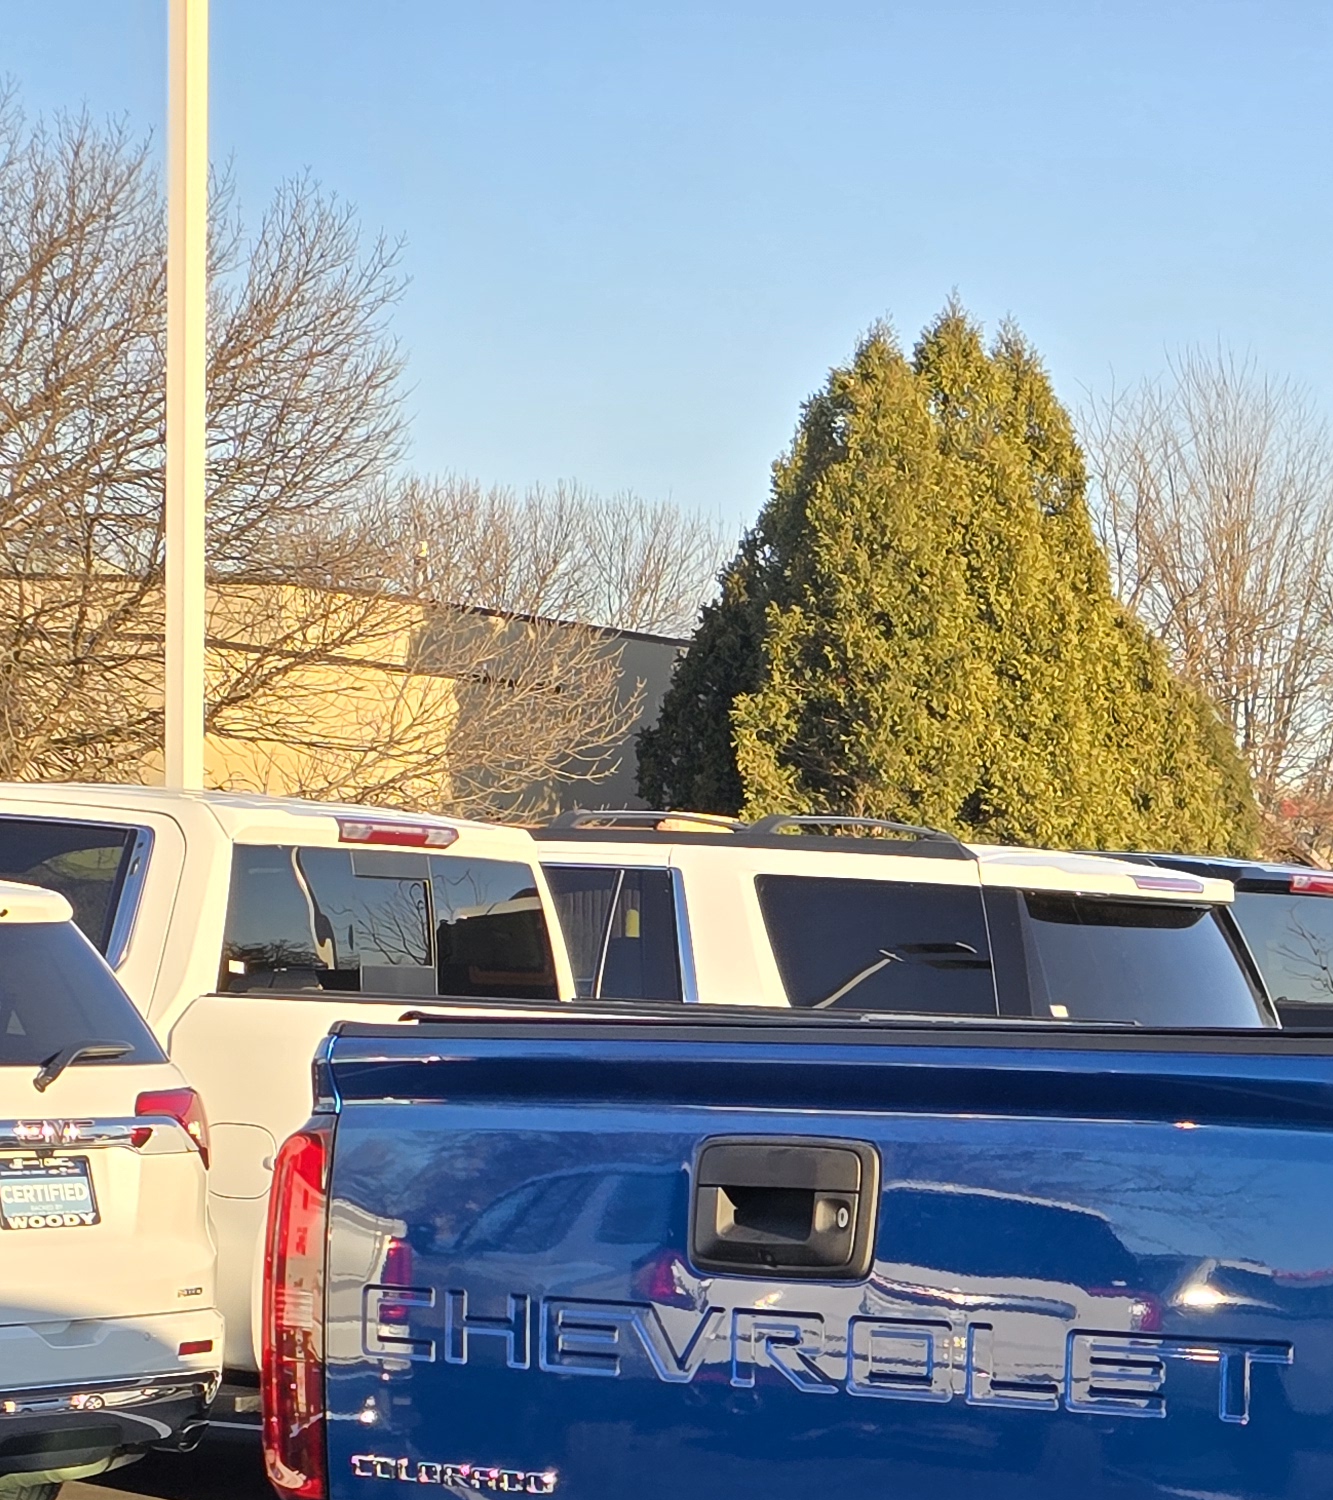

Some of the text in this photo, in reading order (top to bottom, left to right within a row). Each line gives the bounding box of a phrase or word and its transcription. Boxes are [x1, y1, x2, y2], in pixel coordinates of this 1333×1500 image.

[1, 1183, 87, 1203] CERTIFIED
[7, 1212, 96, 1229] WOODY
[360, 1283, 1294, 1425] CHEVROLET
[351, 1454, 556, 1493] COLORADO
